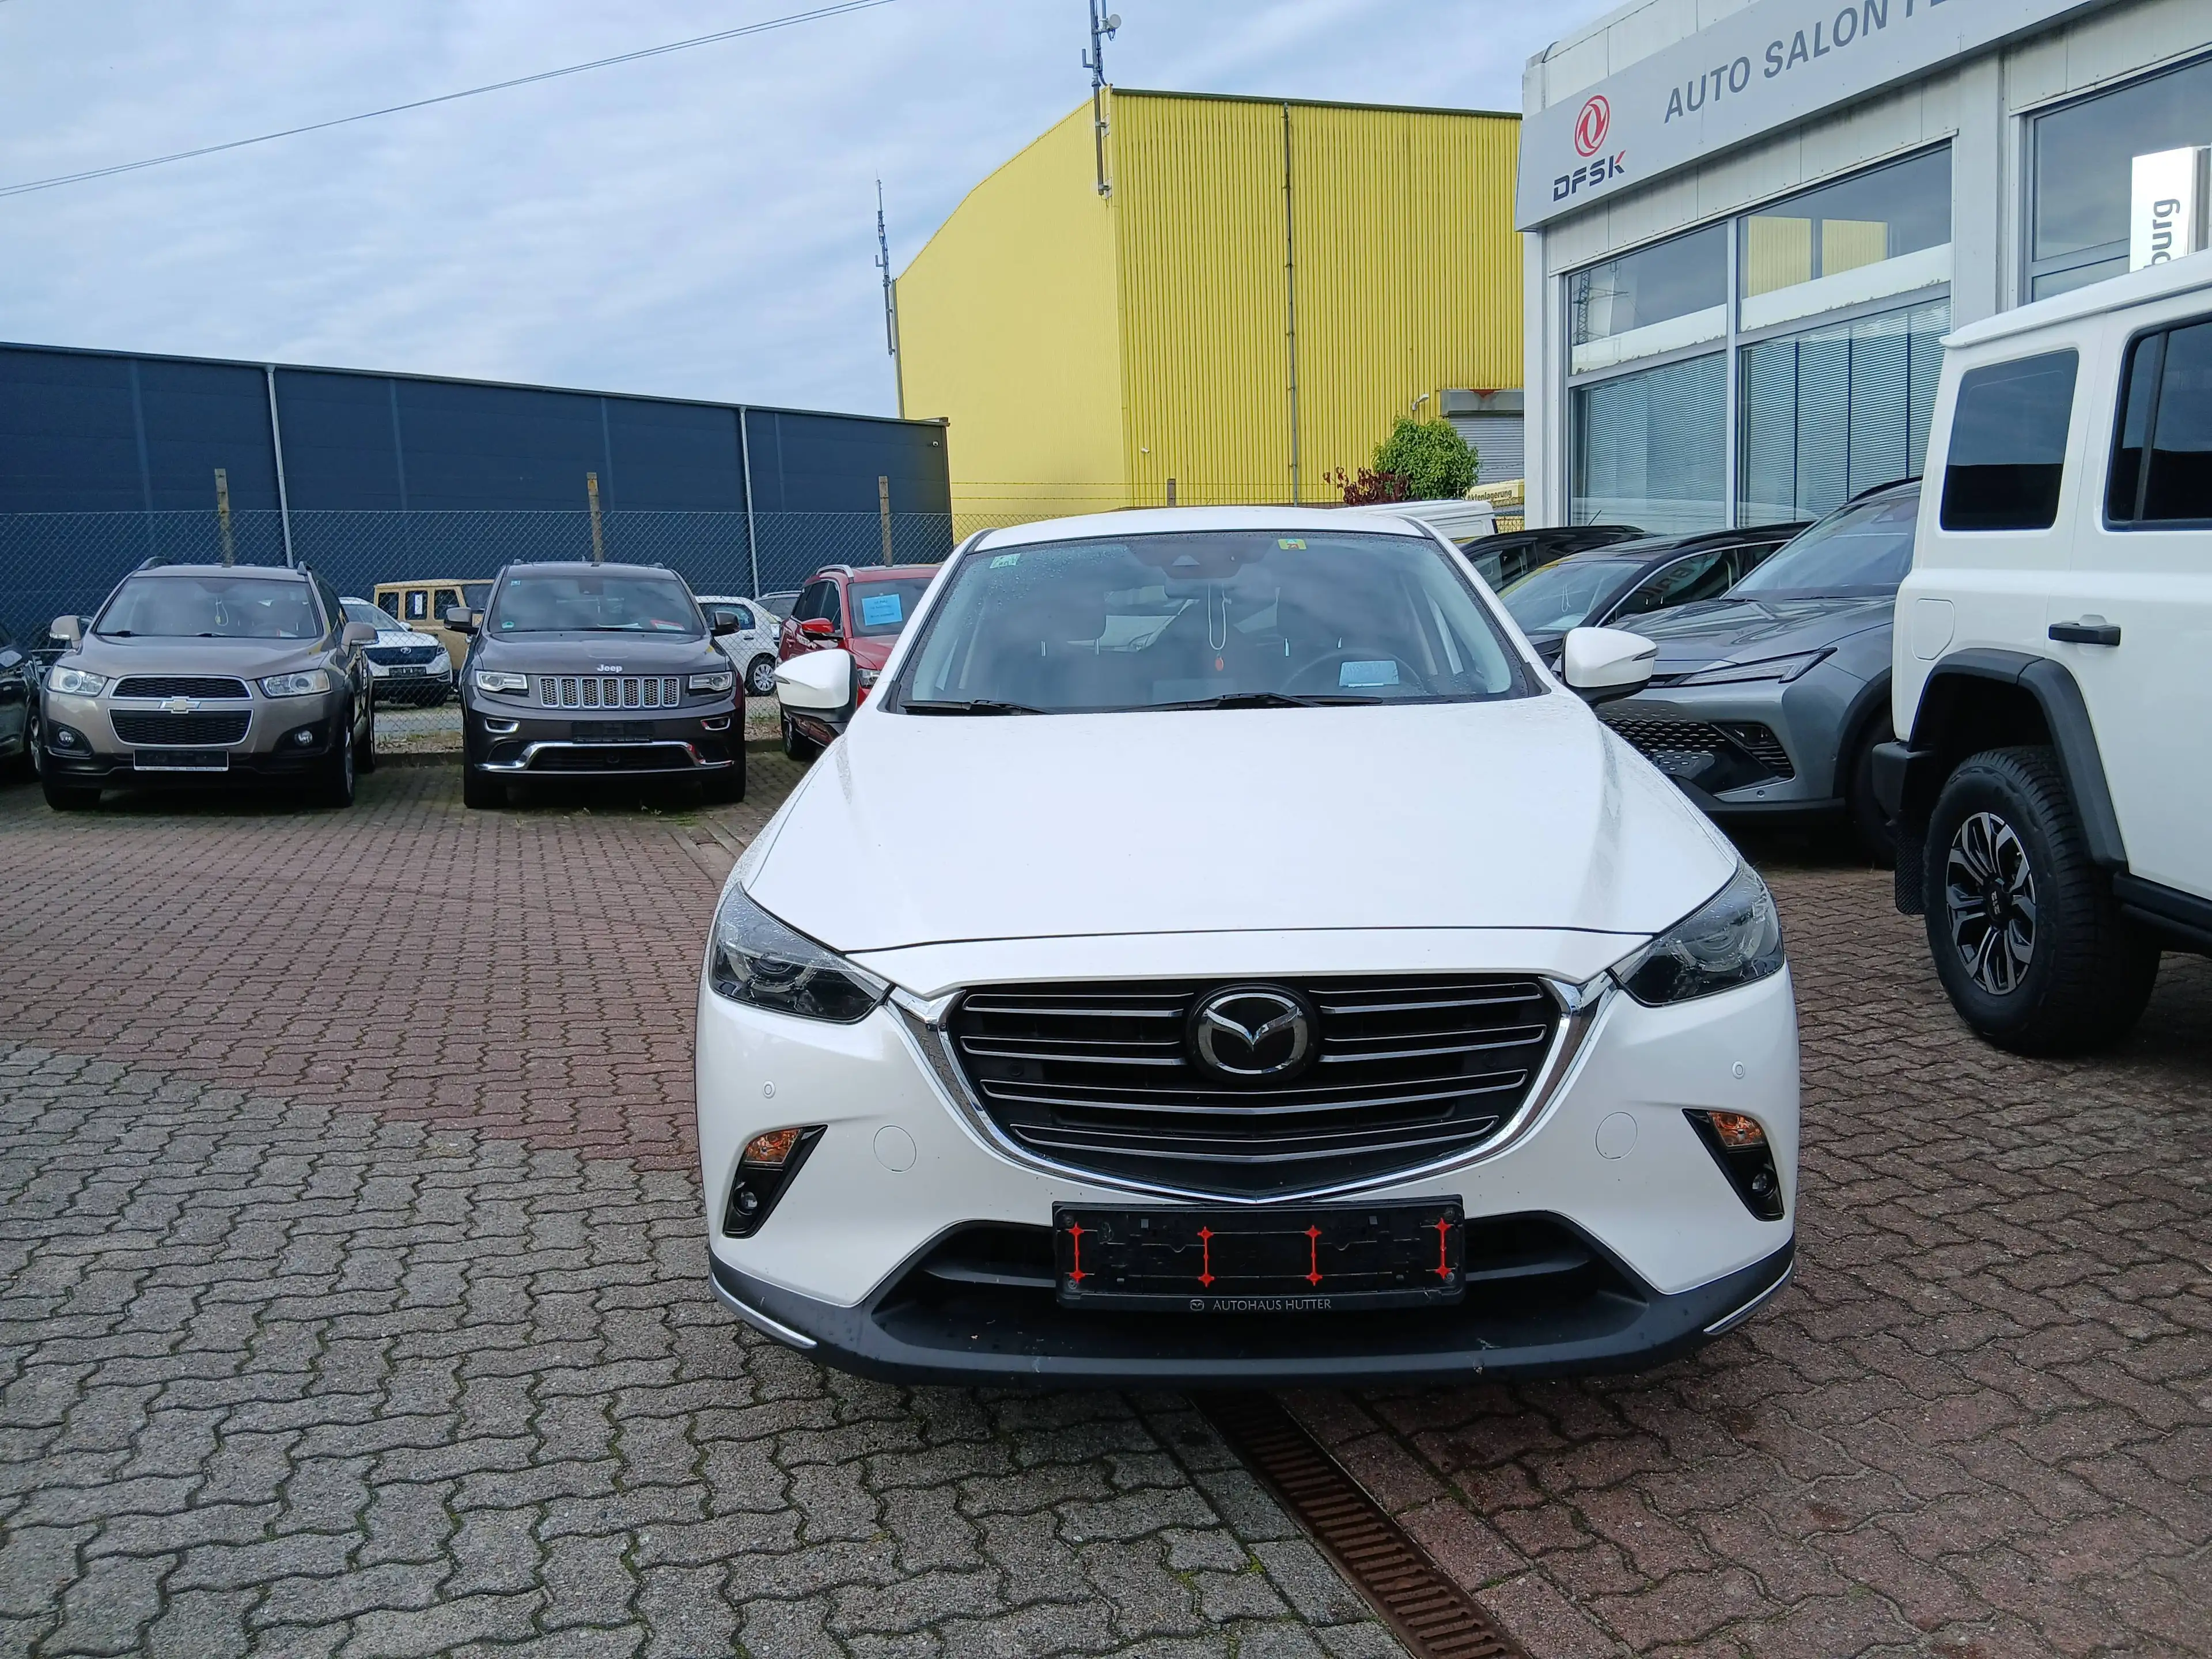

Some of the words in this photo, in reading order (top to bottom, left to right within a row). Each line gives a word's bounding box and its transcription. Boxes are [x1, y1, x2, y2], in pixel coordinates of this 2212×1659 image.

[1664, 56, 1751, 124] AUTO
[1764, 0, 1888, 78] SALON
[1554, 150, 1626, 202] DFSK
[1467, 490, 1512, 502] Aktenlagerung
[597, 664, 623, 673] Jeep
[1213, 1299, 1281, 1310] AUTOHAUS
[1286, 1299, 1331, 1309] HUTTER
